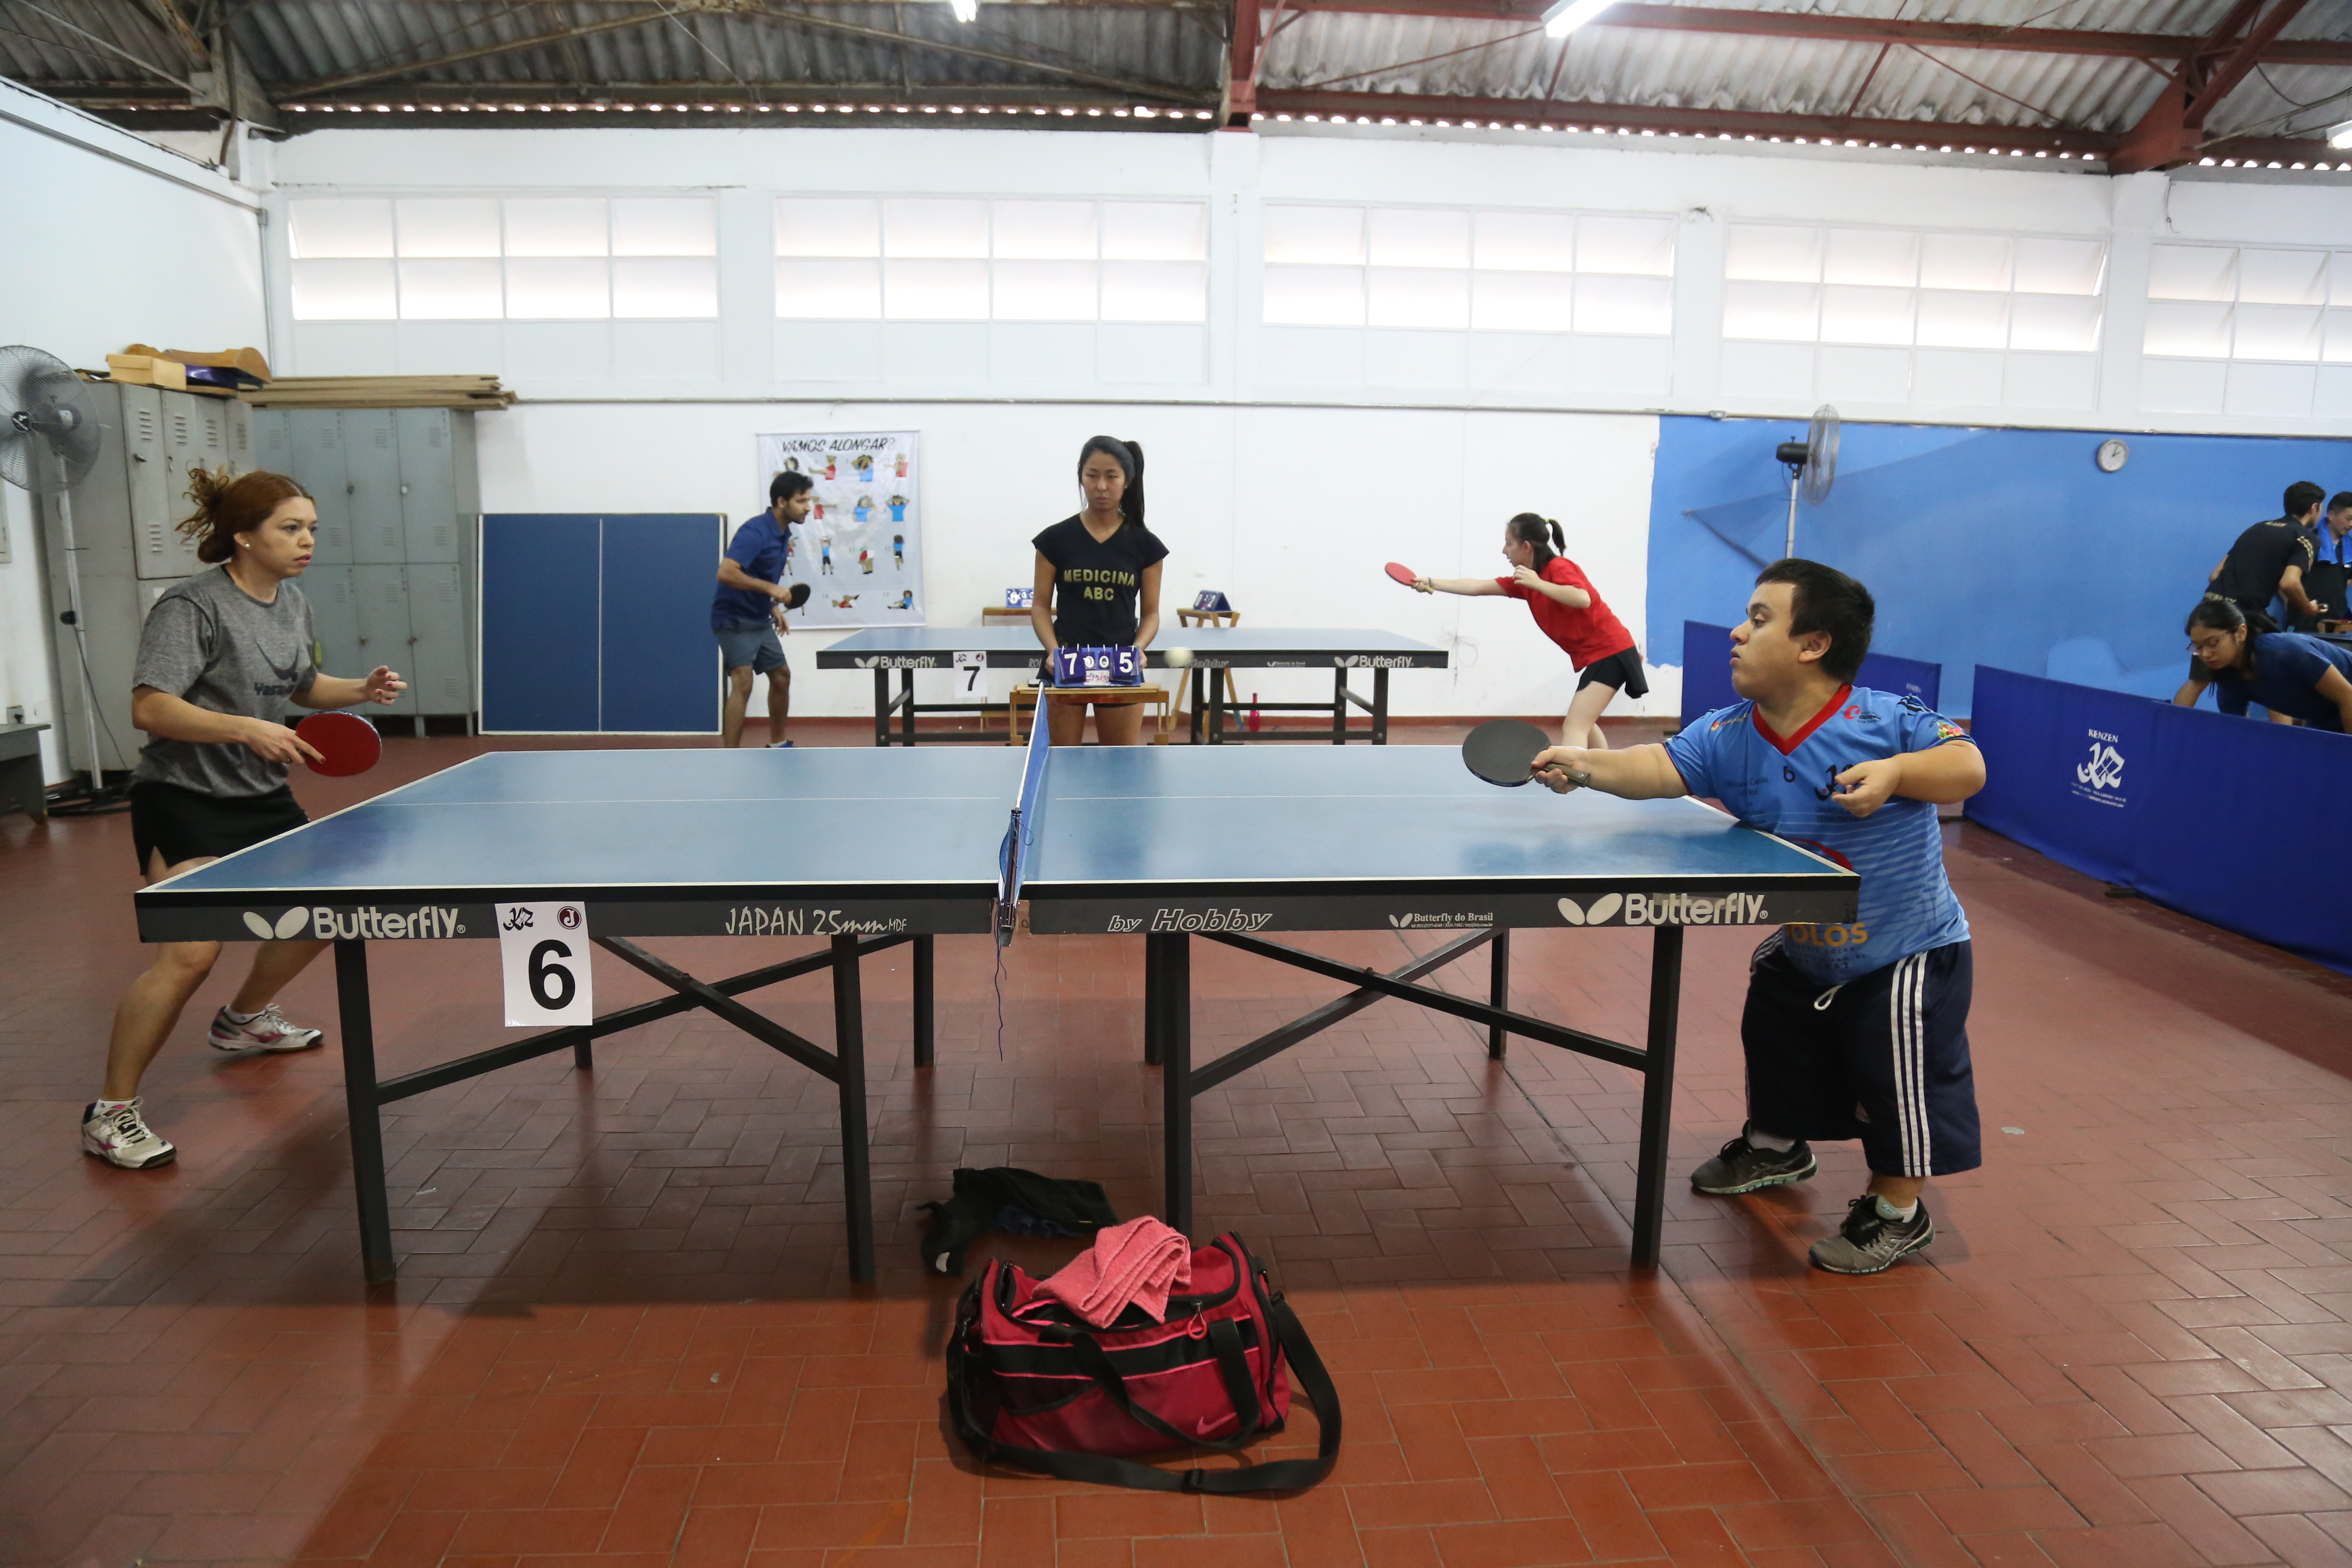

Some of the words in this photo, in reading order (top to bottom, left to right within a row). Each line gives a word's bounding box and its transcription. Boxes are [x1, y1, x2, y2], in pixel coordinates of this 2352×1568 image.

[783, 439, 827, 451] VAMOS
[830, 437, 895, 451] ALONGAR?
[1064, 569, 1135, 587] MEDICINA
[1084, 586, 1114, 600] ABC
[881, 655, 935, 668] Butterfly
[1064, 652, 1078, 675] 7
[1099, 655, 1109, 668] 0
[1119, 652, 1133, 673] 5
[1360, 655, 1412, 668] Butterfly
[963, 666, 980, 691] 7
[2088, 728, 2119, 743] KENZEN
[1107, 915, 1143, 932] by
[1151, 908, 1273, 932] Hobby
[1414, 913, 1452, 923] Butterfly
[1455, 913, 1465, 922] do
[1468, 912, 1493, 921] Brasil
[1625, 893, 1764, 925] Butterfly
[313, 906, 459, 940] Butterfly
[725, 906, 803, 936] JAPAN
[812, 909, 888, 935] 25mm
[888, 918, 907, 932] MDF
[1785, 923, 1868, 947] OLOS
[528, 939, 576, 1010] 6
